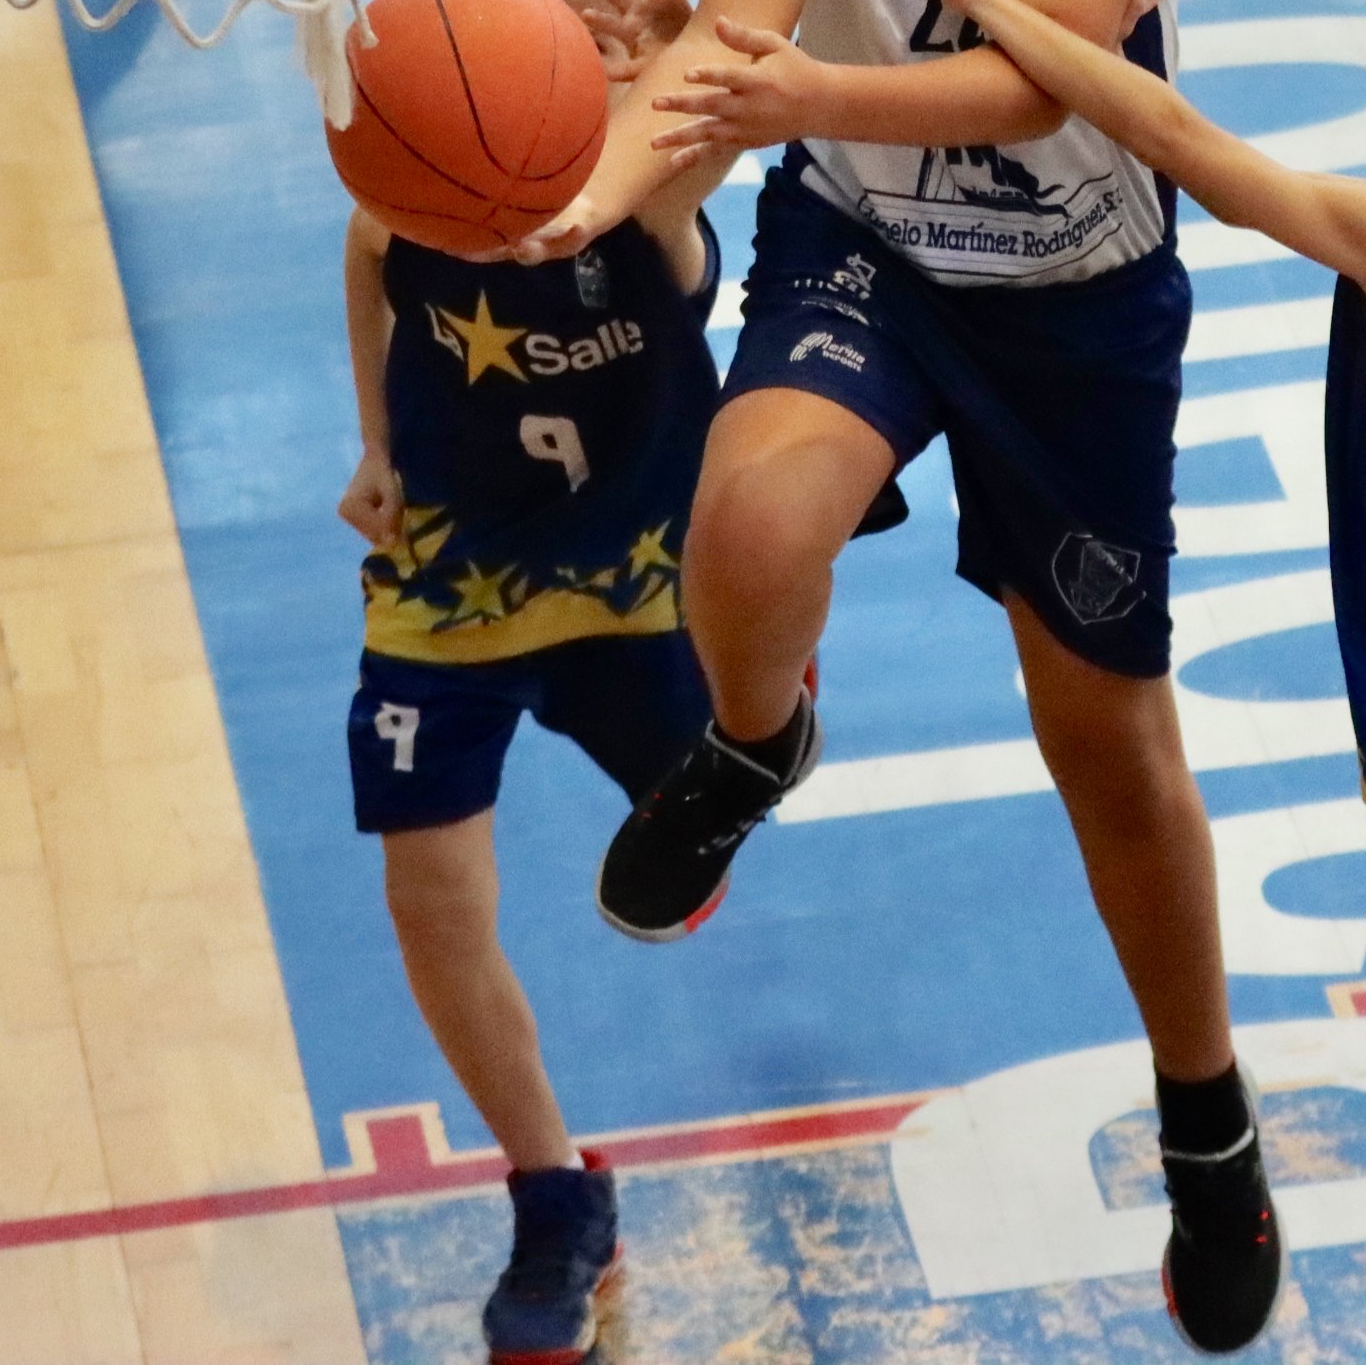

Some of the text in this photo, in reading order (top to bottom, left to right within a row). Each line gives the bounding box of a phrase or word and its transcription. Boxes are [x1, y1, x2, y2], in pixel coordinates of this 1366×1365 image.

[925, 221, 1018, 255] Martínez
[1022, 202, 1107, 258] Rodríguez
[519, 414, 591, 493] 9
[374, 701, 420, 772] 9
